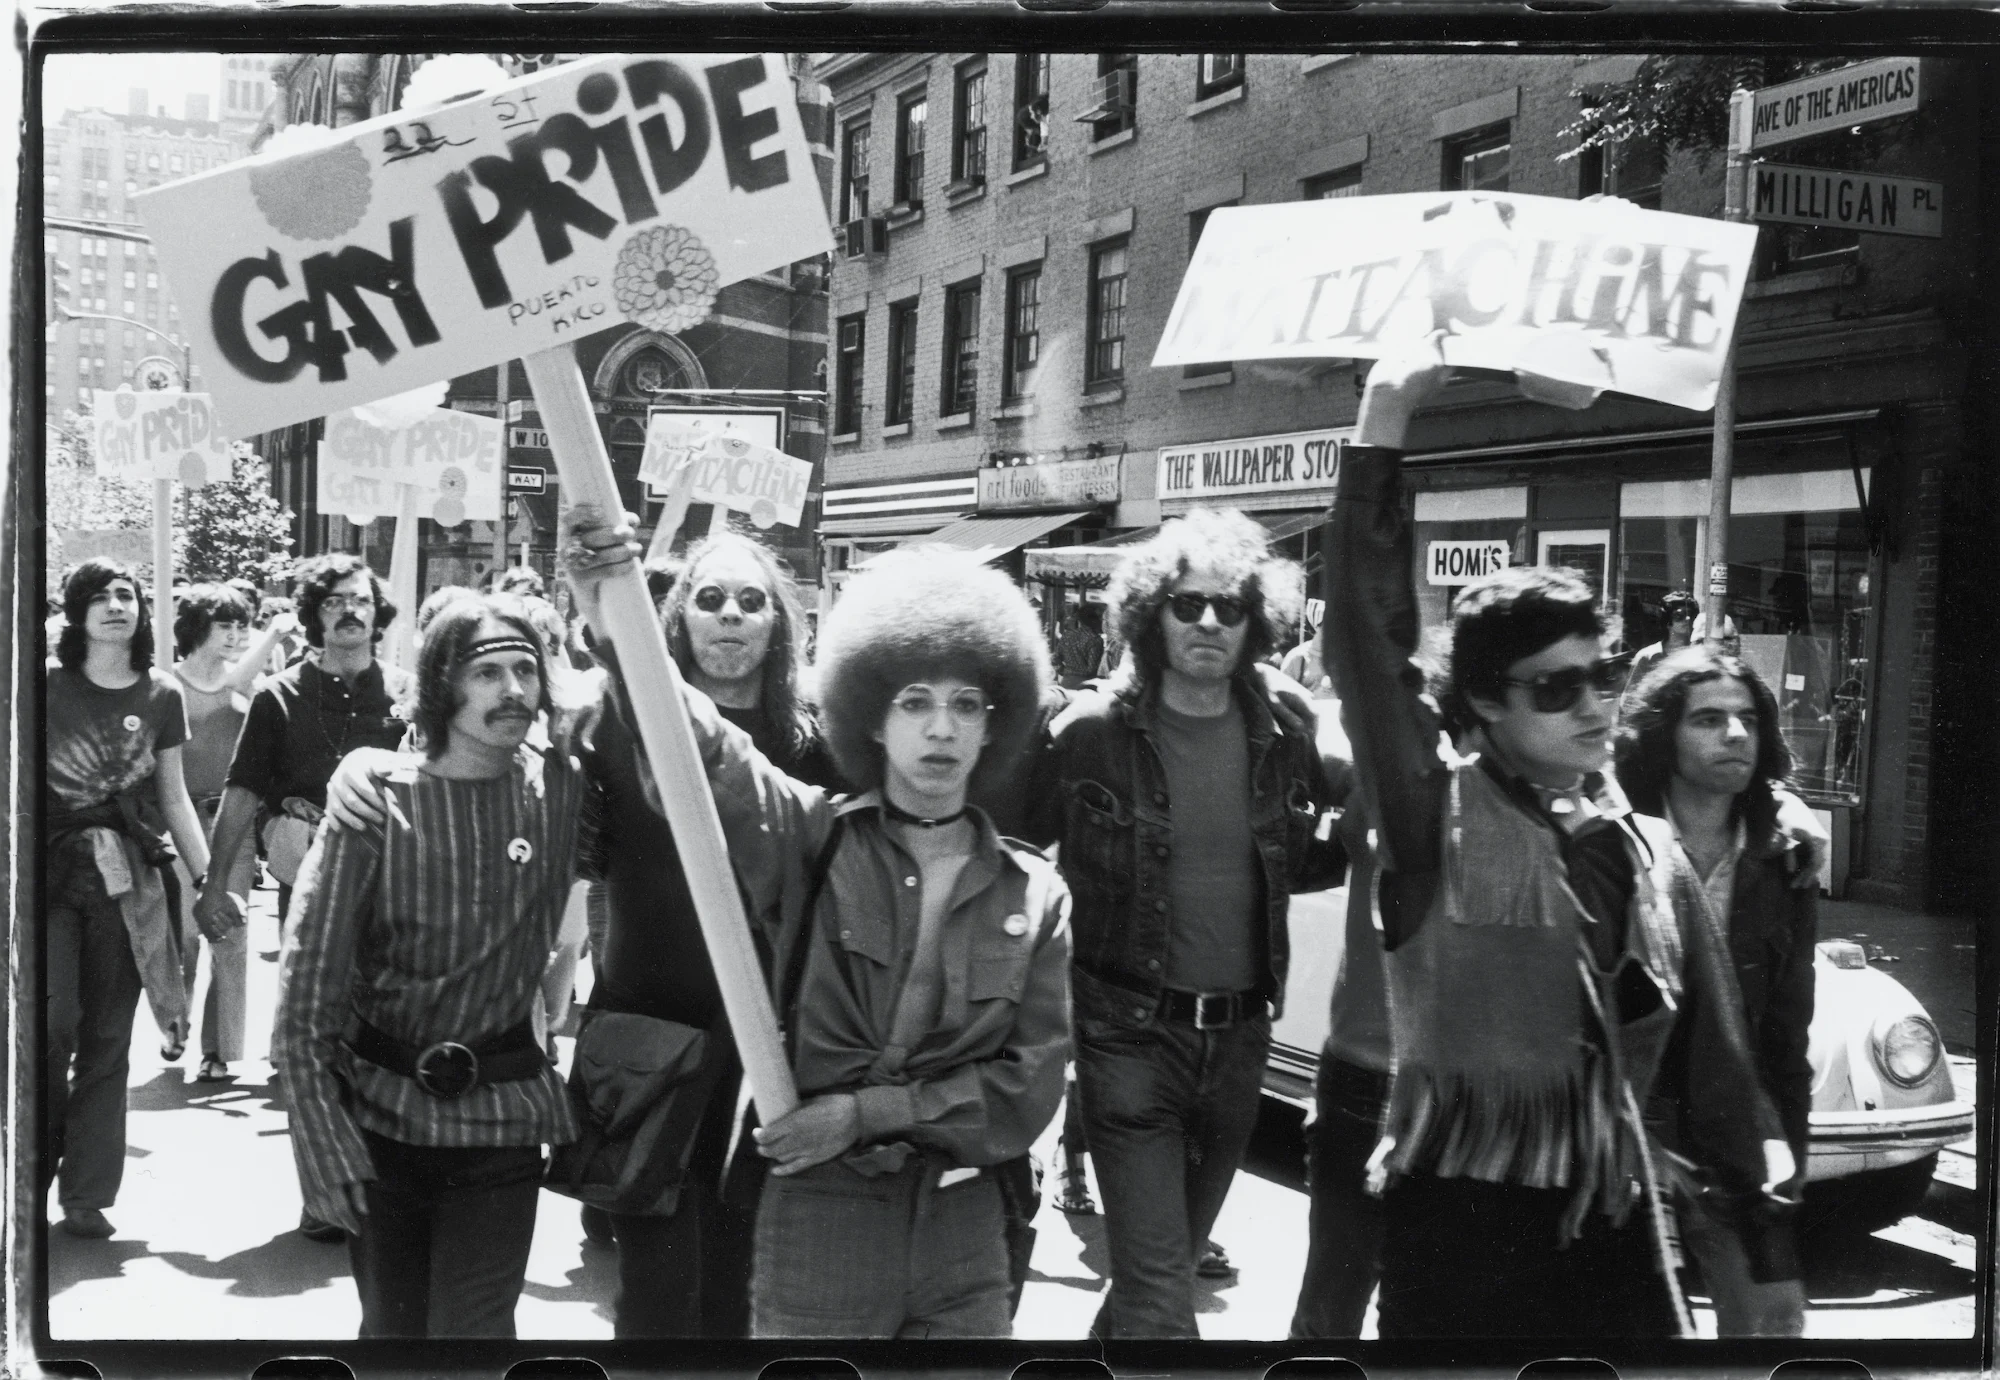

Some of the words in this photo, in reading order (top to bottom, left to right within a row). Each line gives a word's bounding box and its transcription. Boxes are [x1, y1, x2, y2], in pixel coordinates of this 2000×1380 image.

[1755, 101, 1780, 135] AVE
[1784, 96, 1804, 127] OF
[1807, 87, 1833, 121] THE
[1836, 66, 1915, 116] AMERICAS
[1755, 170, 1898, 227] MILLIGAN
[1913, 187, 1938, 212] PL
[210, 215, 440, 384] GAY
[507, 274, 600, 326] PUERTO
[553, 302, 606, 333] RICO
[100, 420, 138, 467] GAY
[330, 414, 400, 468] GAY
[515, 431, 528, 446] W
[533, 430, 549, 448] 10
[1165, 454, 1195, 490] THE
[1203, 444, 1294, 487] WALLPAPER
[1303, 438, 1350, 480] STO
[515, 475, 538, 486] WAY
